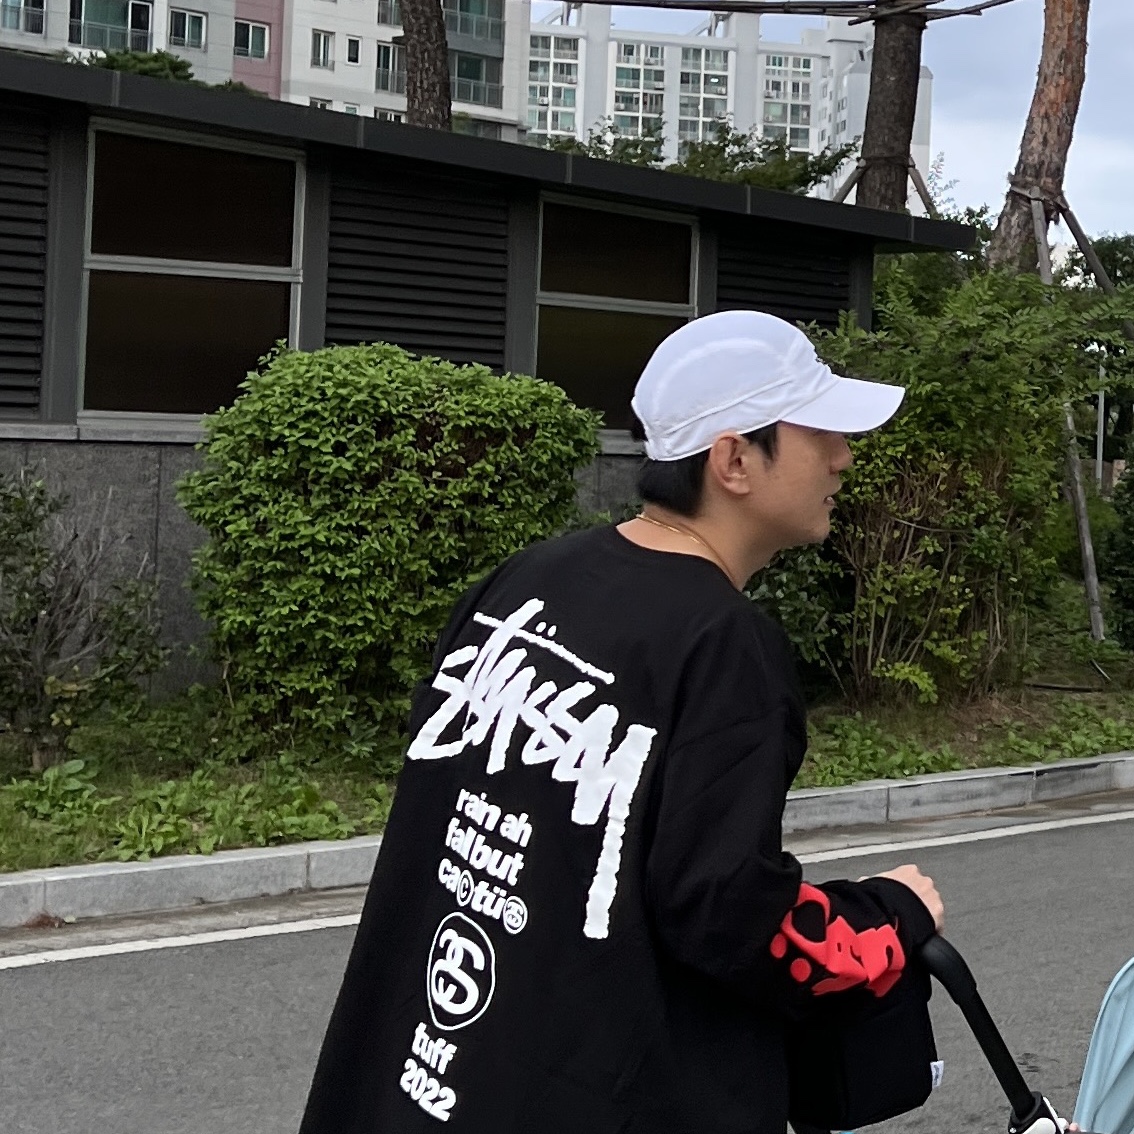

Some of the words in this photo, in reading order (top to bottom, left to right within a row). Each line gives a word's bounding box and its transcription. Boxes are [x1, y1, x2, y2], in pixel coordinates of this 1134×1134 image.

[455, 788, 501, 832] rain
[500, 812, 532, 848] ah
[411, 1021, 458, 1075] tuff
[399, 1058, 457, 1122] 2022
